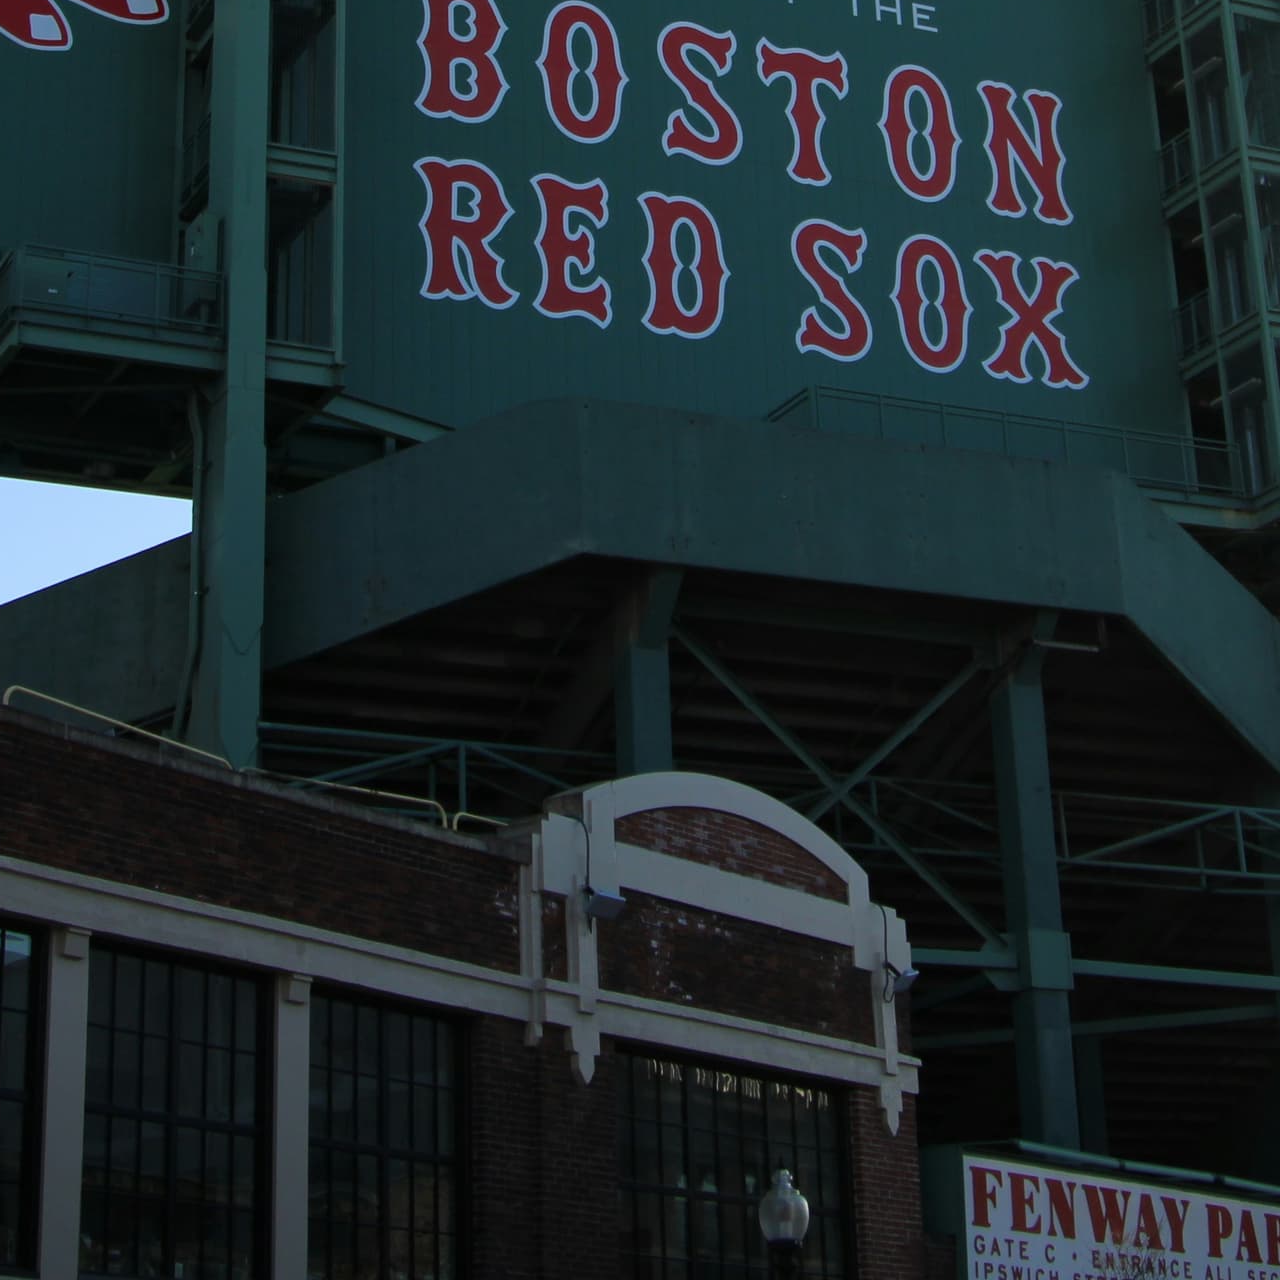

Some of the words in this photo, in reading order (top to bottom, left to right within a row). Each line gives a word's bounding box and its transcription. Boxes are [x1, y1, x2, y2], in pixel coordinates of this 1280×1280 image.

[413, 155, 731, 340] RED
[791, 218, 1090, 390] SOX
[970, 1166, 1191, 1254] FENWAY
[974, 1235, 1029, 1261] GATE
[1045, 1244, 1056, 1263] C
[1092, 1250, 1193, 1279] ENTRANCE
